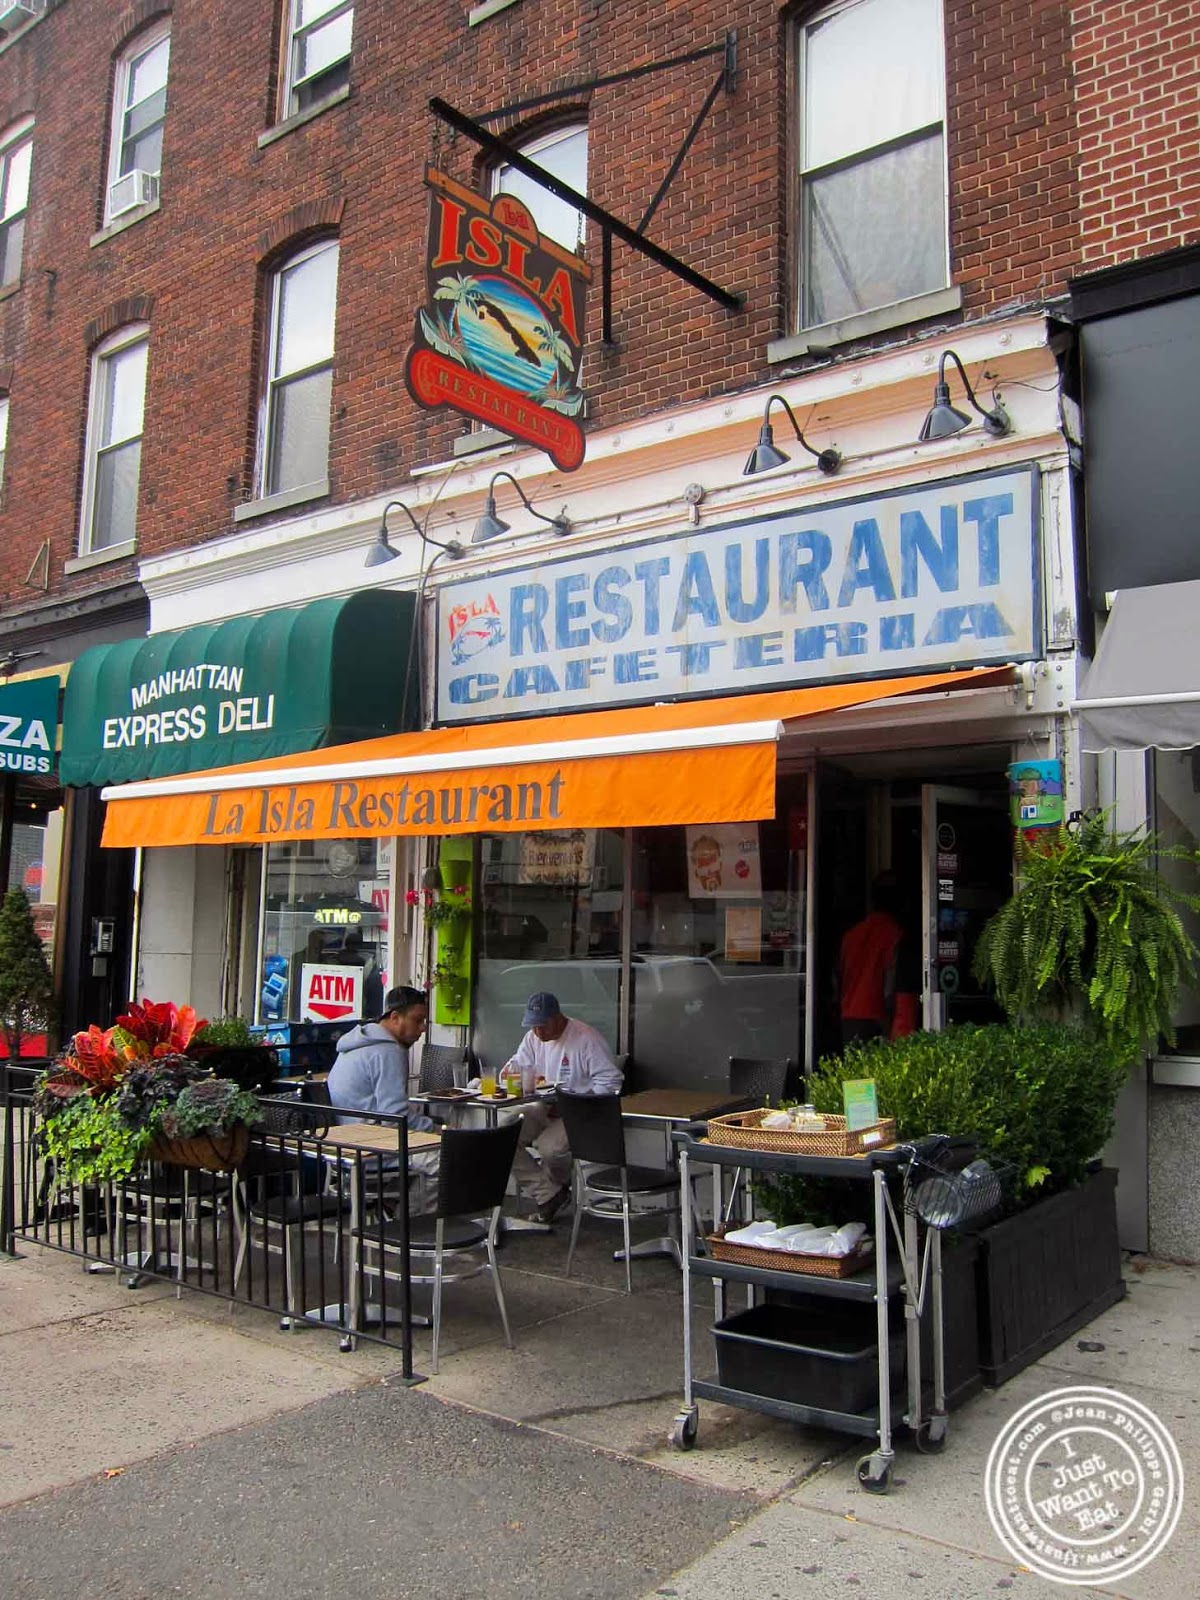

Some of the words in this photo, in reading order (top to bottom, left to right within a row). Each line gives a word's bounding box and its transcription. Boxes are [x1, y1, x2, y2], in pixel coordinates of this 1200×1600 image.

[431, 195, 581, 348] ISLA
[437, 369, 565, 442] RESTAURANT
[509, 492, 1014, 657] RESTAURANT
[447, 592, 501, 644] ISLA
[448, 600, 1016, 705] CAFETERIA
[103, 705, 207, 749] EXPRESS
[218, 694, 275, 734] DELI
[131, 664, 244, 710] MANHATTAN
[201, 792, 244, 837] La
[255, 787, 316, 835] Isla
[326, 768, 566, 831] Restaurant
[309, 974, 355, 1003] ATM
